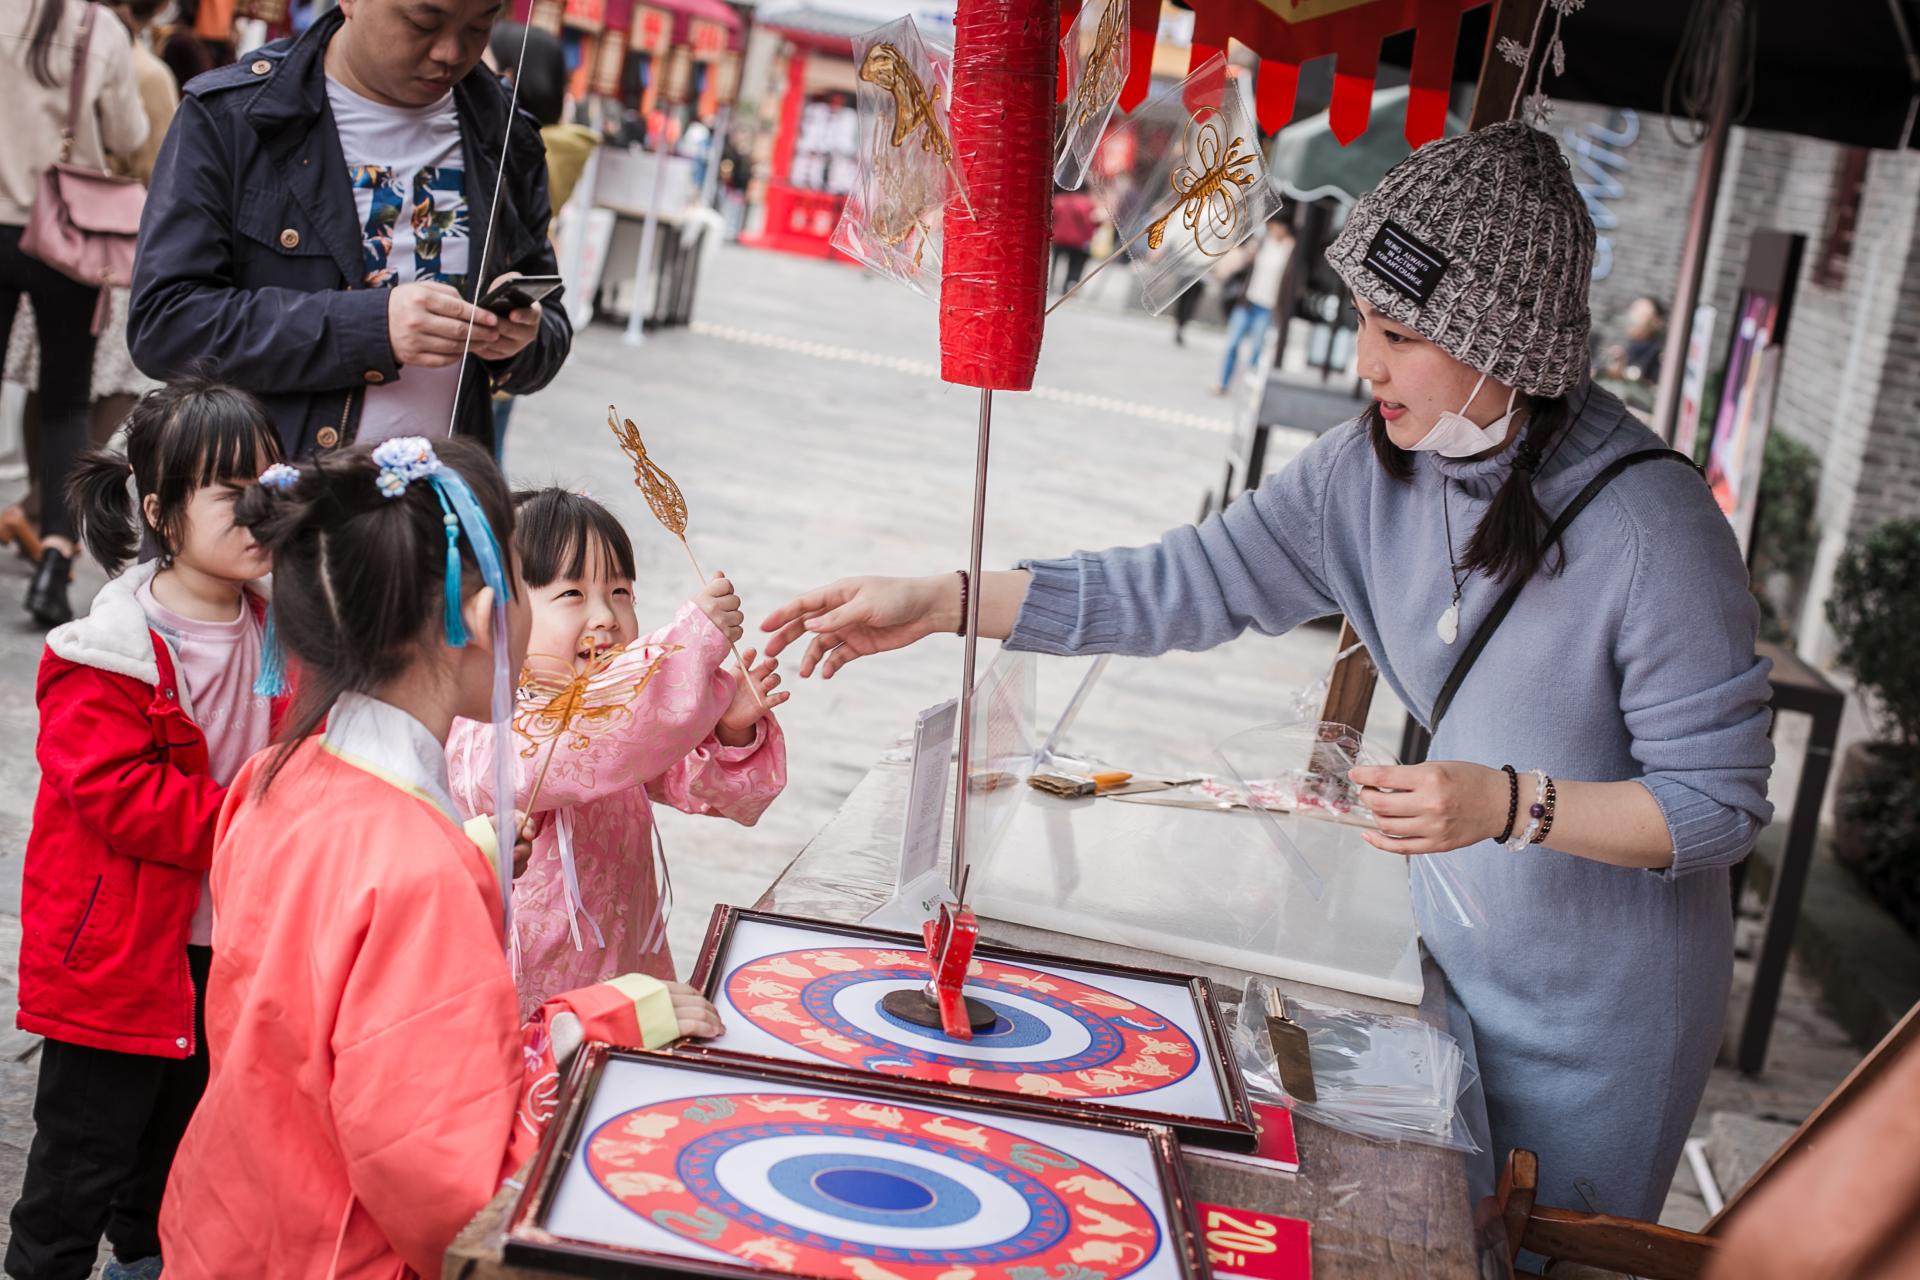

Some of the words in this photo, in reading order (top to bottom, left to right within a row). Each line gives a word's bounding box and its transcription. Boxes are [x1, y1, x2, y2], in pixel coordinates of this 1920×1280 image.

[1384, 238, 1402, 253] BEING
[1403, 251, 1429, 272] ALWAYS
[1393, 254, 1418, 273] ACTION
